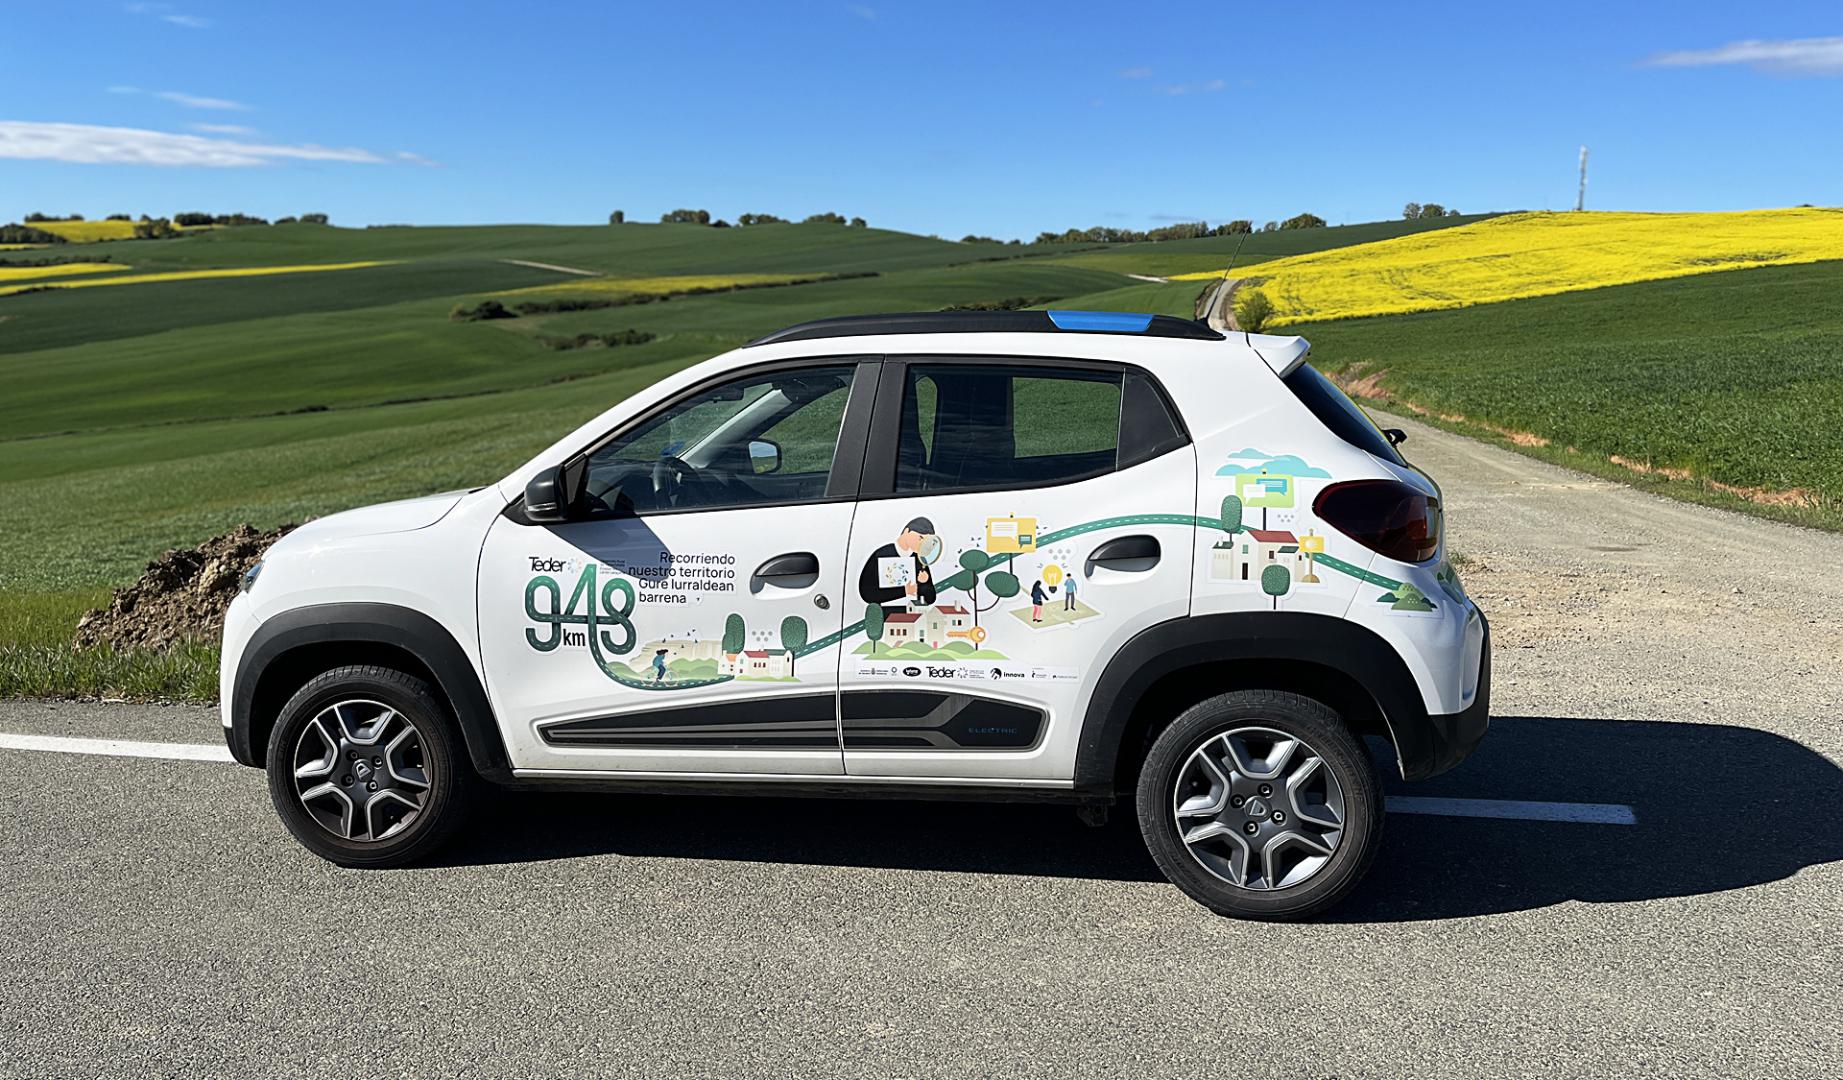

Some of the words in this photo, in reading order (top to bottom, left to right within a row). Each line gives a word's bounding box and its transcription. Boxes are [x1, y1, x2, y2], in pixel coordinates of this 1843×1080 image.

[529, 556, 566, 572] Teder
[660, 551, 735, 565] Recorriendo
[628, 565, 676, 577] nuestro
[679, 566, 735, 579] territorio
[639, 578, 668, 589] Gure
[671, 578, 734, 591] lurraldean
[639, 591, 687, 604] barrena
[563, 628, 585, 647] km
[926, 666, 956, 678] Teder
